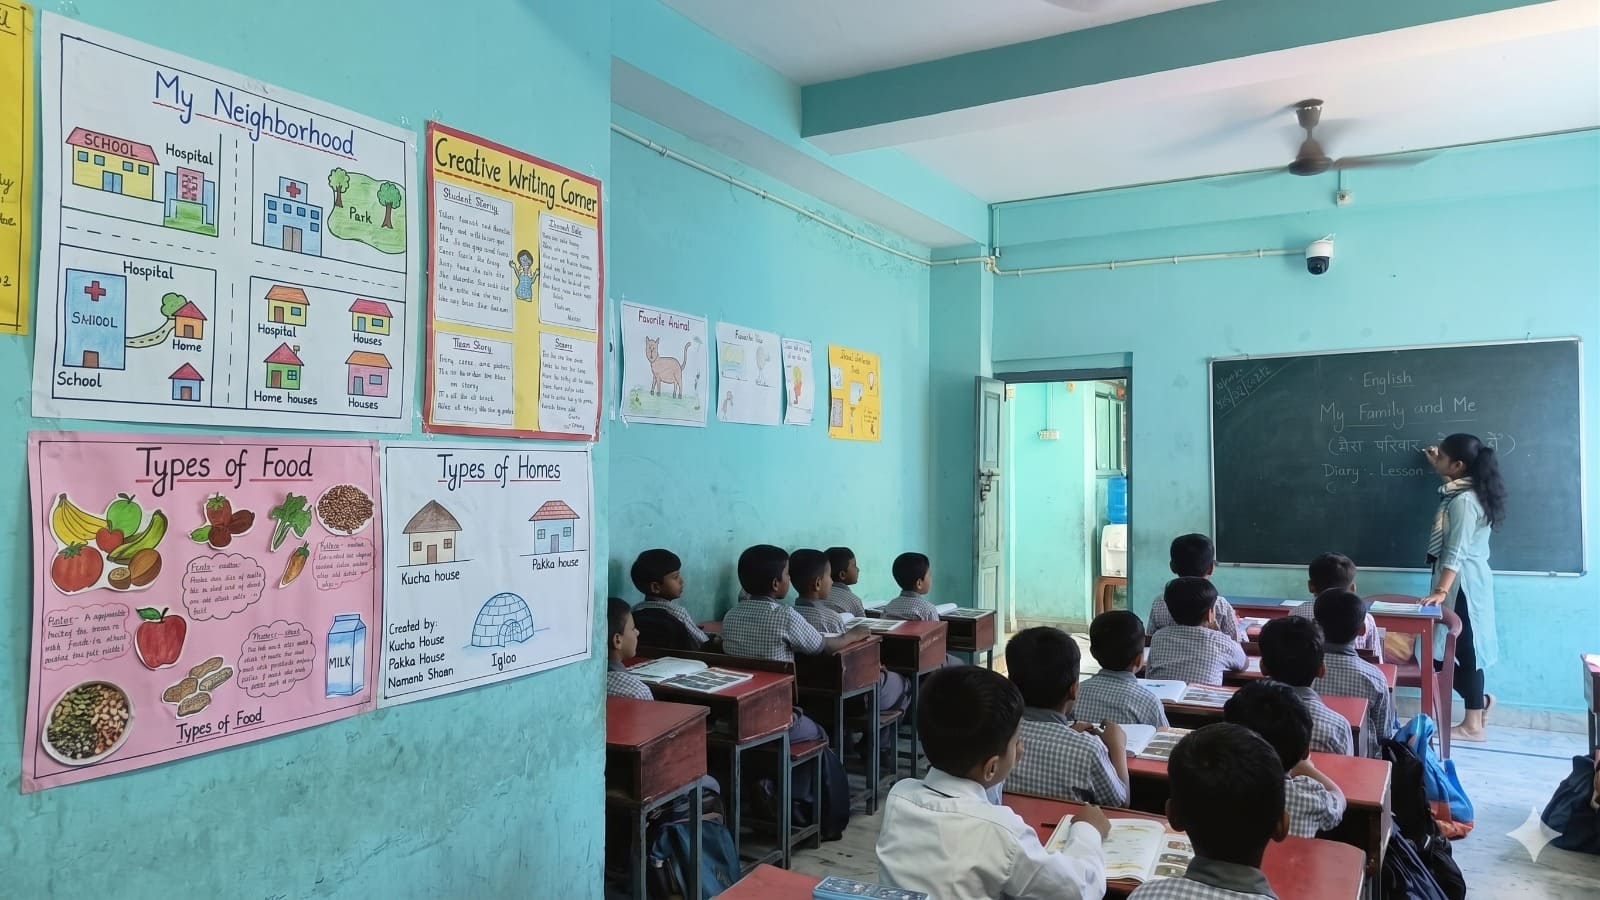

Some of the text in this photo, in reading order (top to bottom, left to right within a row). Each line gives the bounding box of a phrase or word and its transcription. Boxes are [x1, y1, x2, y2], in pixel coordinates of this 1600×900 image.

[154, 70, 355, 157] My Neighborhood
[84, 133, 138, 158] SCHOOL
[165, 142, 214, 166] Hospital
[435, 138, 597, 213] Creative Writing Corner
[443, 187, 473, 205] Student
[348, 206, 374, 225] Park
[122, 260, 175, 281] Hospital
[257, 322, 297, 339] Hospital
[638, 310, 690, 332] Favorite Animal
[172, 338, 203, 354] Home
[353, 332, 383, 347] Houses
[473, 340, 492, 354] Story
[56, 371, 104, 389] School
[1363, 369, 1413, 395] English
[254, 389, 318, 405] Home houses
[348, 397, 379, 410] Houses
[1320, 395, 1478, 433] My Family and Me
[136, 447, 314, 498] Types of Food
[437, 453, 561, 491] Types of Homes
[1321, 462, 1423, 484] Diary Lesson
[532, 556, 579, 571] Pakka house
[401, 569, 461, 586] Kucha house
[389, 619, 438, 636] Created by:
[388, 633, 445, 653] Kucha House
[328, 654, 351, 671] MILK
[388, 651, 445, 671] Pakka House
[490, 652, 517, 673] Igloo
[176, 707, 263, 743] Types of Food
